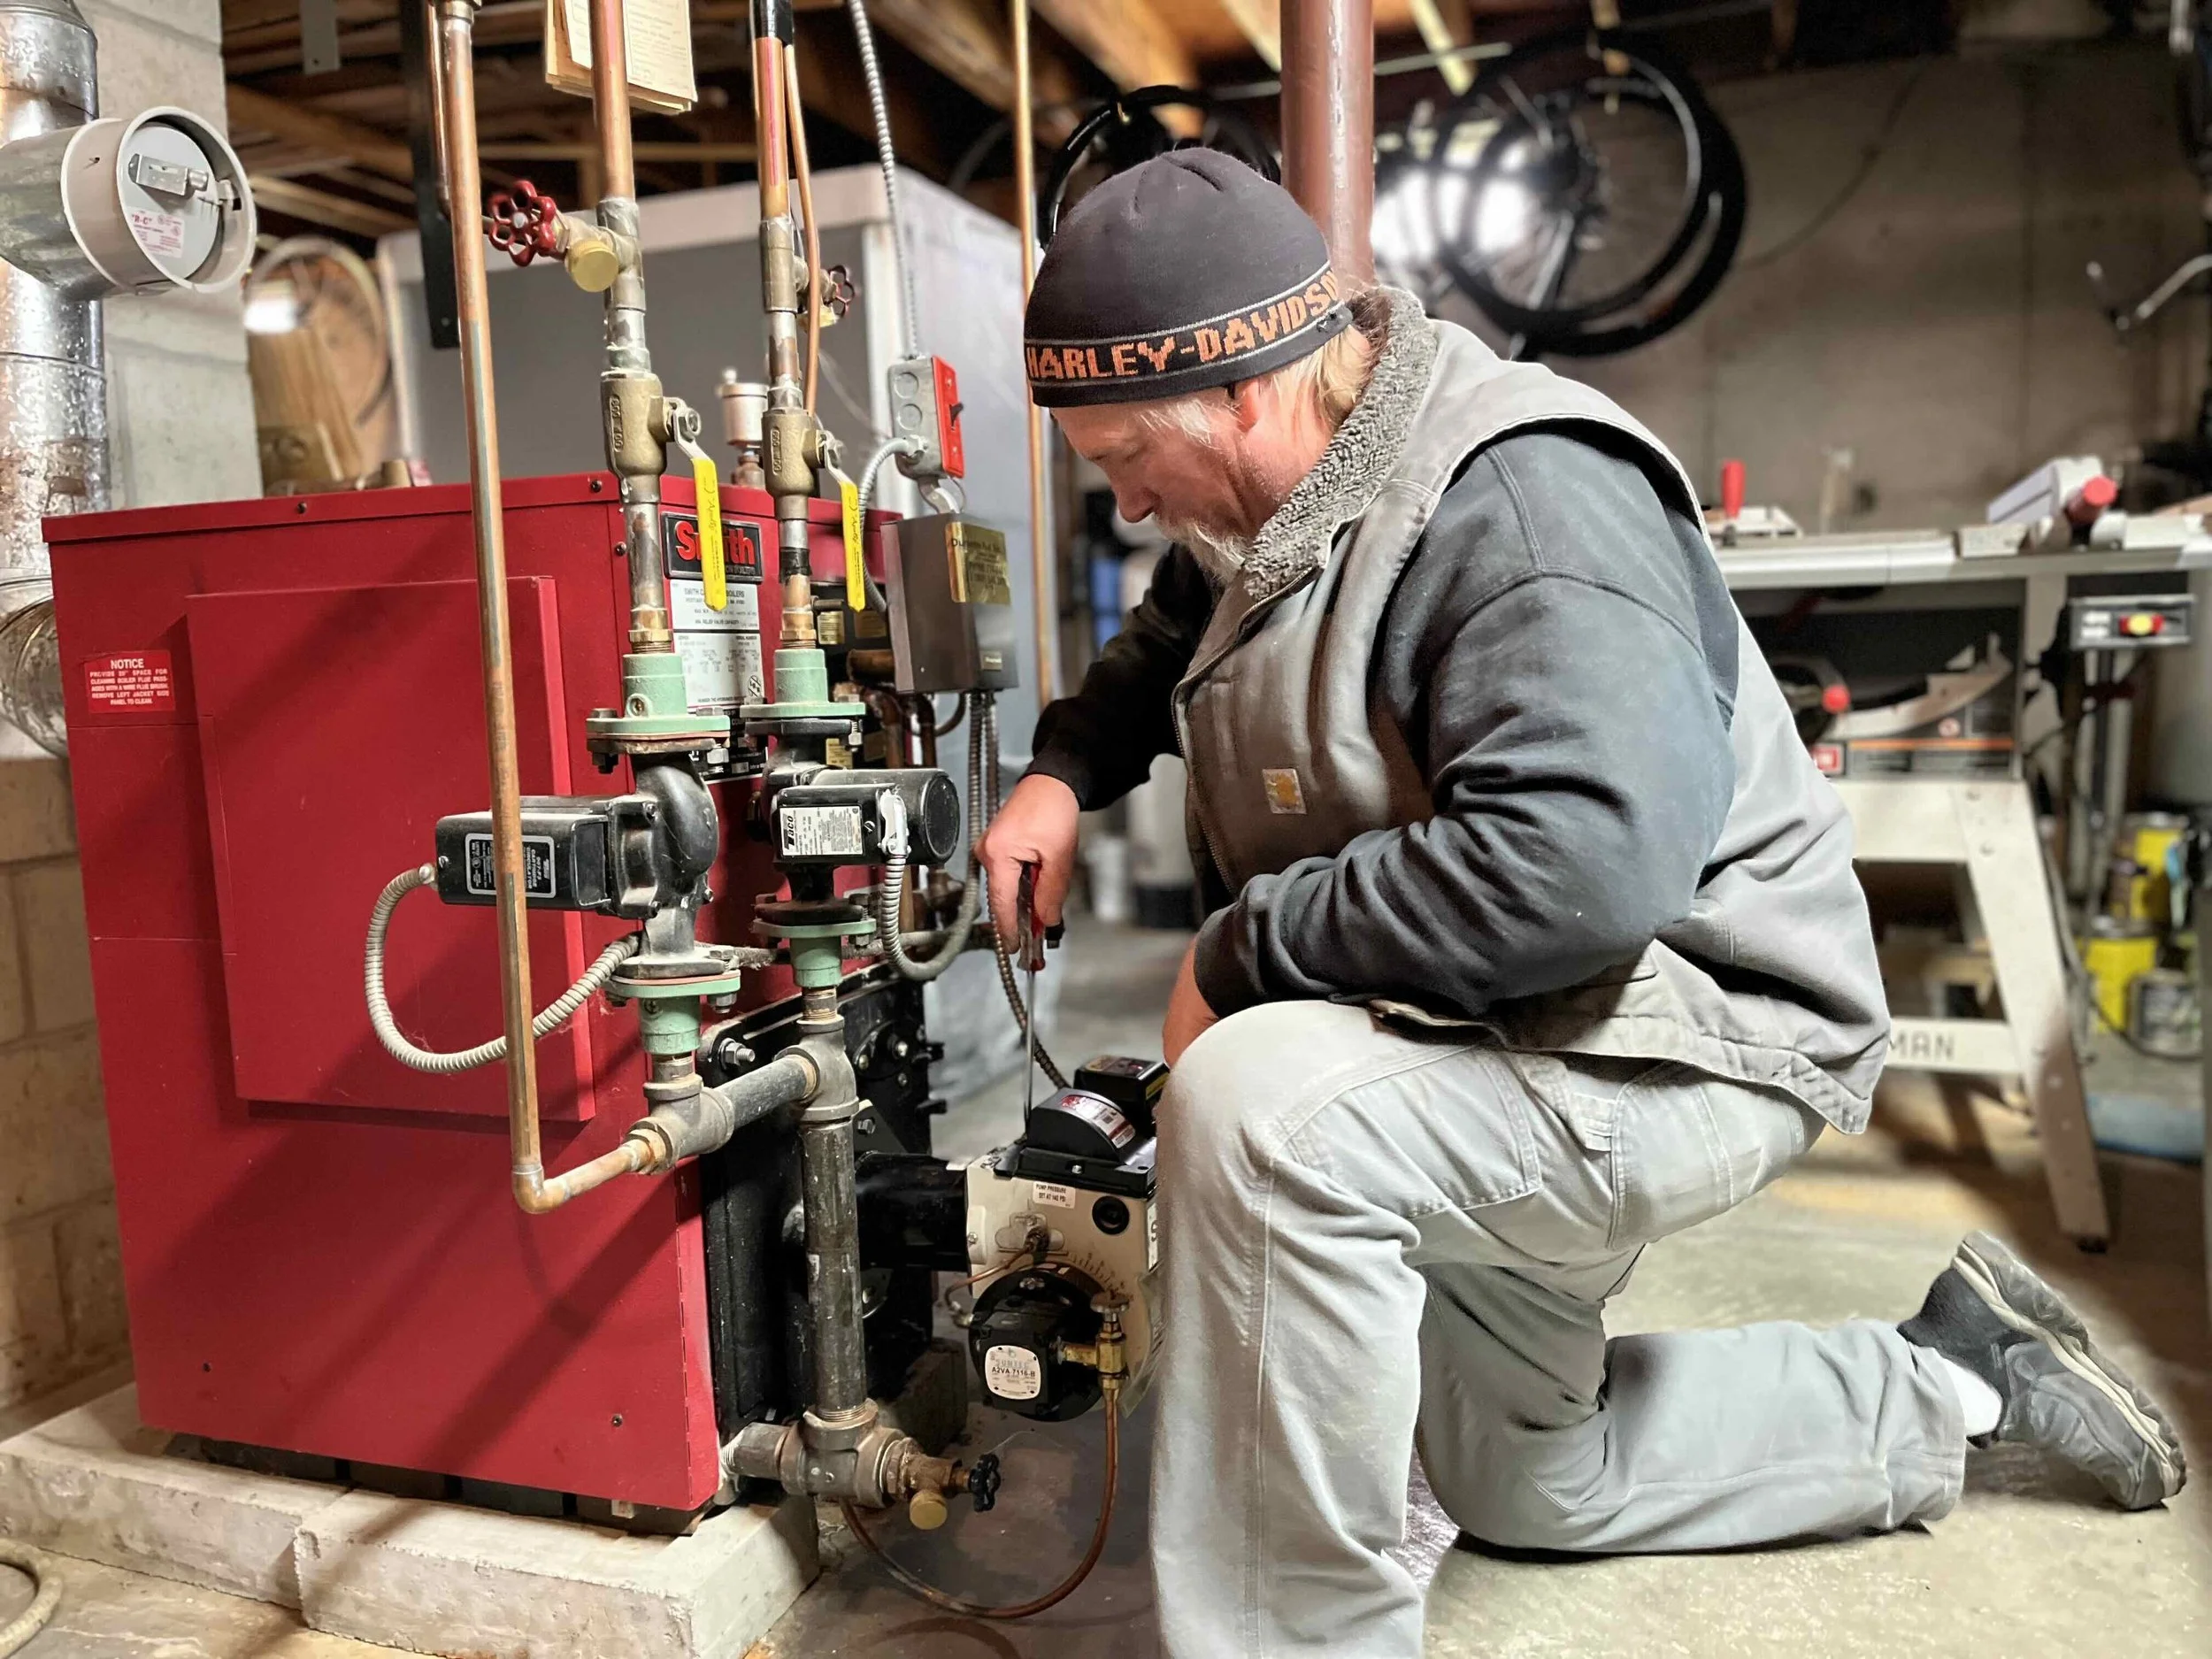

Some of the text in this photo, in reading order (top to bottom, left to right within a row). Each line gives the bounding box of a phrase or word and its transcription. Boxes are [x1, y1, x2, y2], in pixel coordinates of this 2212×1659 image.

[1026, 270, 1339, 379] HARLEY-DAVIDSO
[675, 520, 756, 565] Sith
[111, 658, 144, 669] NOTICE
[783, 815, 795, 849] Taco
